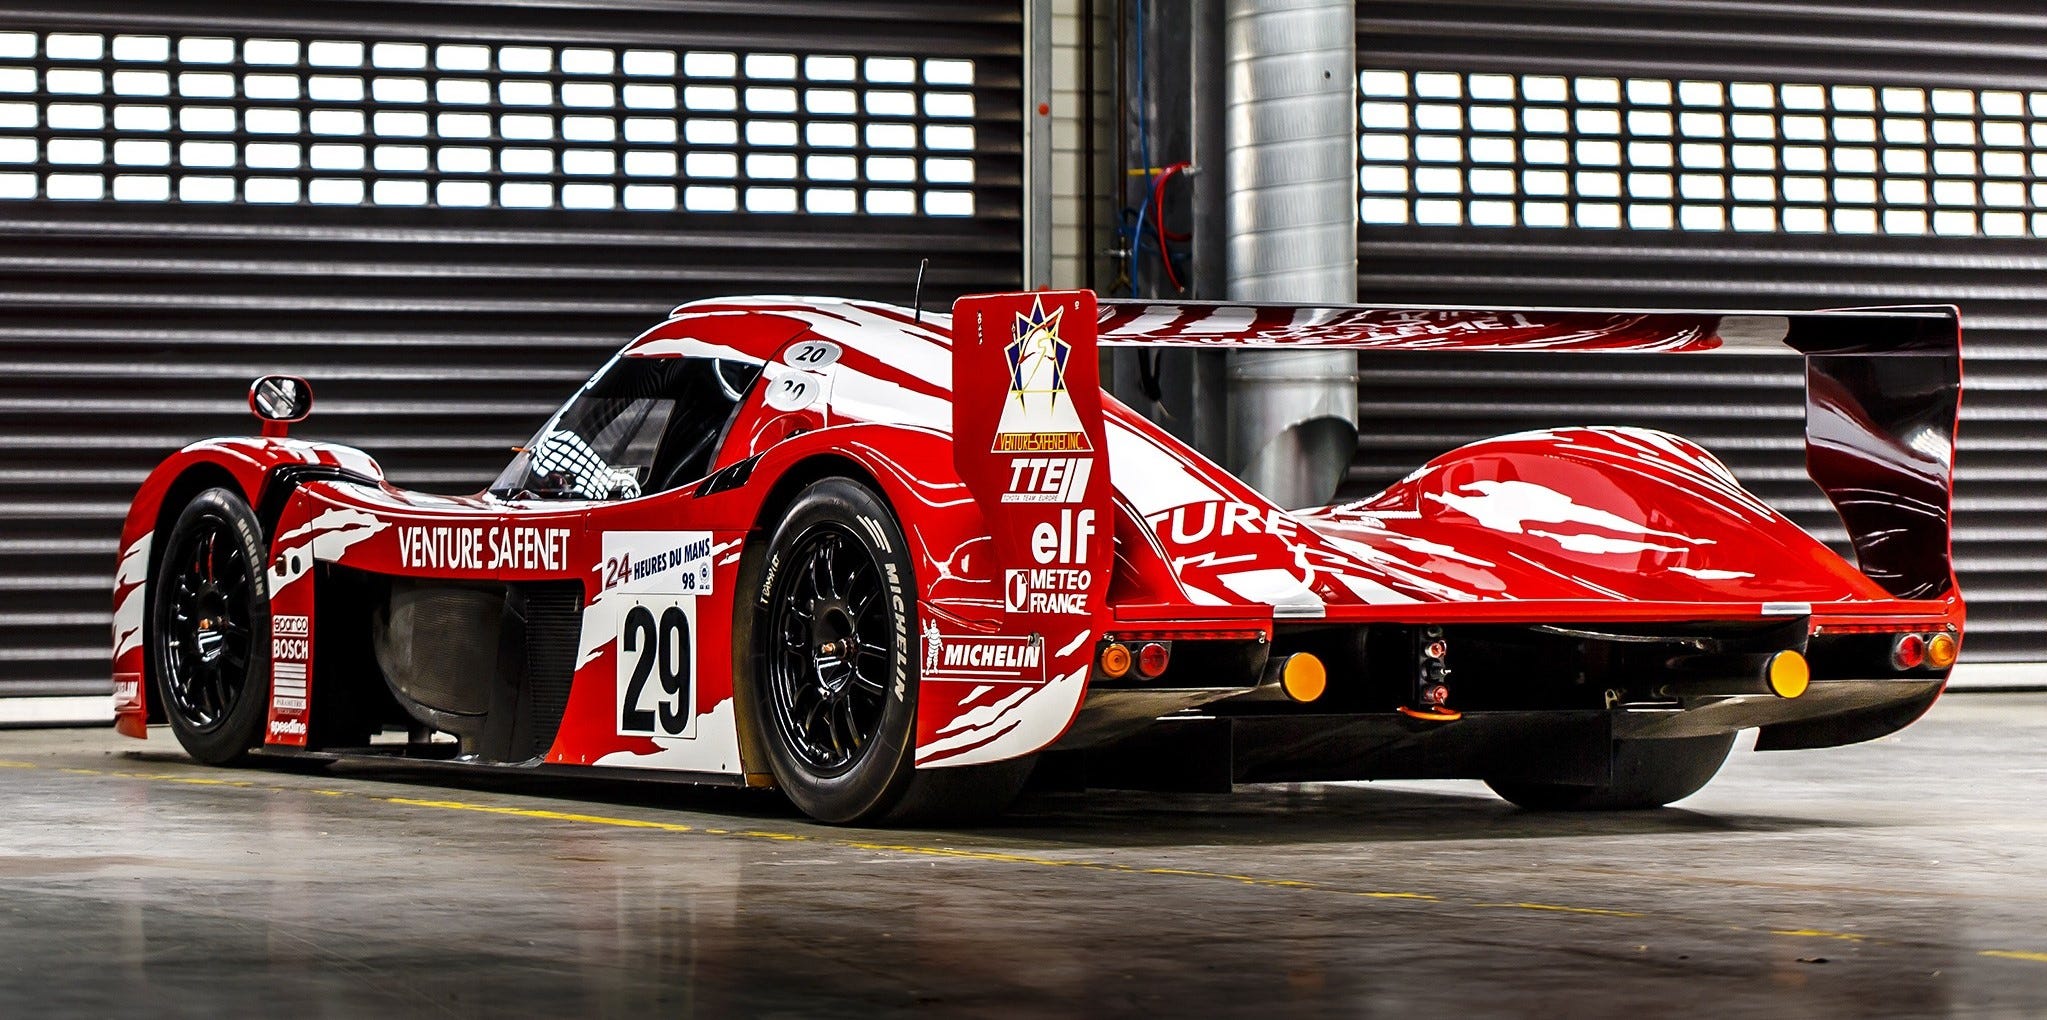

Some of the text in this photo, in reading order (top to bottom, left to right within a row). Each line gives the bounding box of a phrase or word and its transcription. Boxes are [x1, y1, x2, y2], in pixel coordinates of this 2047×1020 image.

[795, 345, 827, 363] 20
[1009, 458, 1067, 492] TTE
[1003, 494, 1058, 502] TOYOTA TEAM EUROPE
[1031, 509, 1096, 564] elf
[237, 518, 264, 596] MICHELIN
[398, 526, 571, 571] VENTURE SAFENET
[604, 537, 711, 590] 24 HEURES DU MANS
[682, 572, 696, 590] 98
[1030, 569, 1092, 590] METEO
[1030, 593, 1089, 614] FRANCE
[274, 617, 307, 632] sparco
[884, 563, 907, 703] MICHELIN
[273, 639, 309, 659] BOSCH
[944, 644, 1041, 667] MICHELIN
[622, 605, 691, 735] 29
[270, 719, 306, 735] speedline
